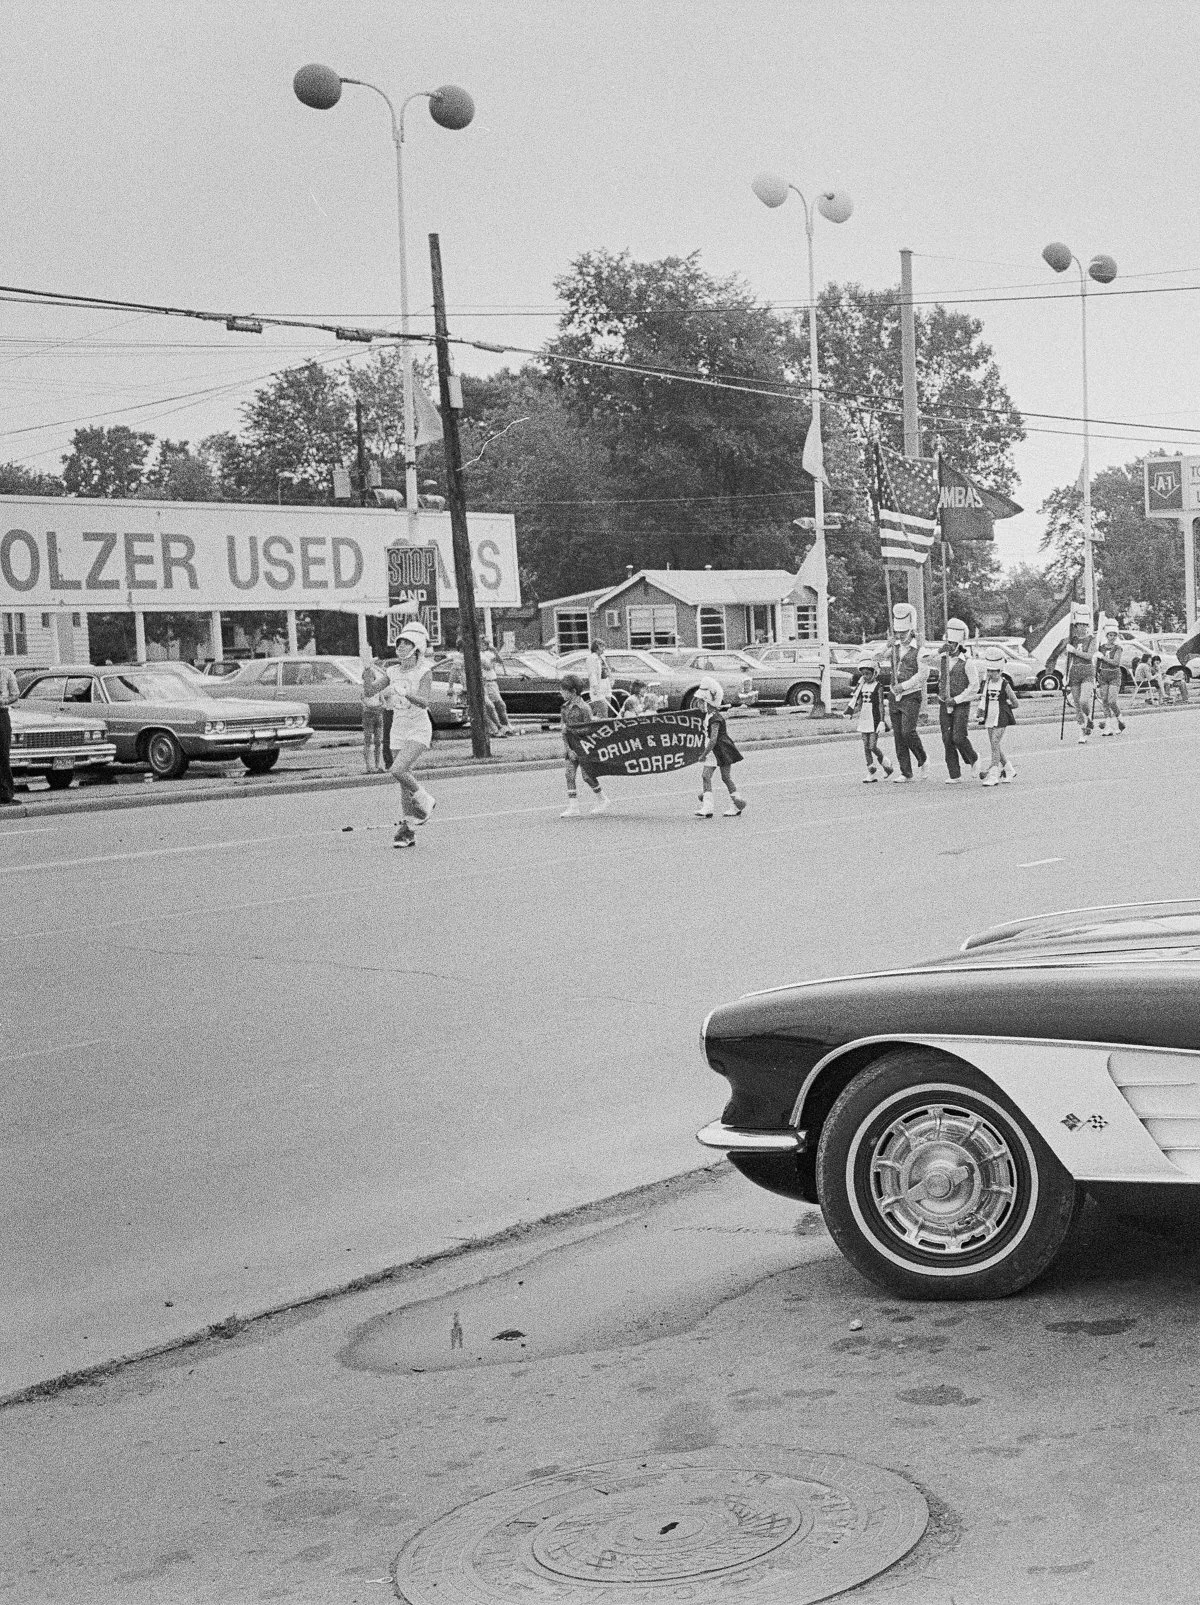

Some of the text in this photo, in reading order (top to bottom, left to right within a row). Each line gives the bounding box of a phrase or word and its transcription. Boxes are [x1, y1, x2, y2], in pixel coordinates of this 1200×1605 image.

[0, 528, 199, 592] OLZER
[226, 535, 364, 591] USED
[388, 549, 436, 586] STOP
[400, 590, 428, 601] AND
[597, 733, 703, 762] DRUM & BATON
